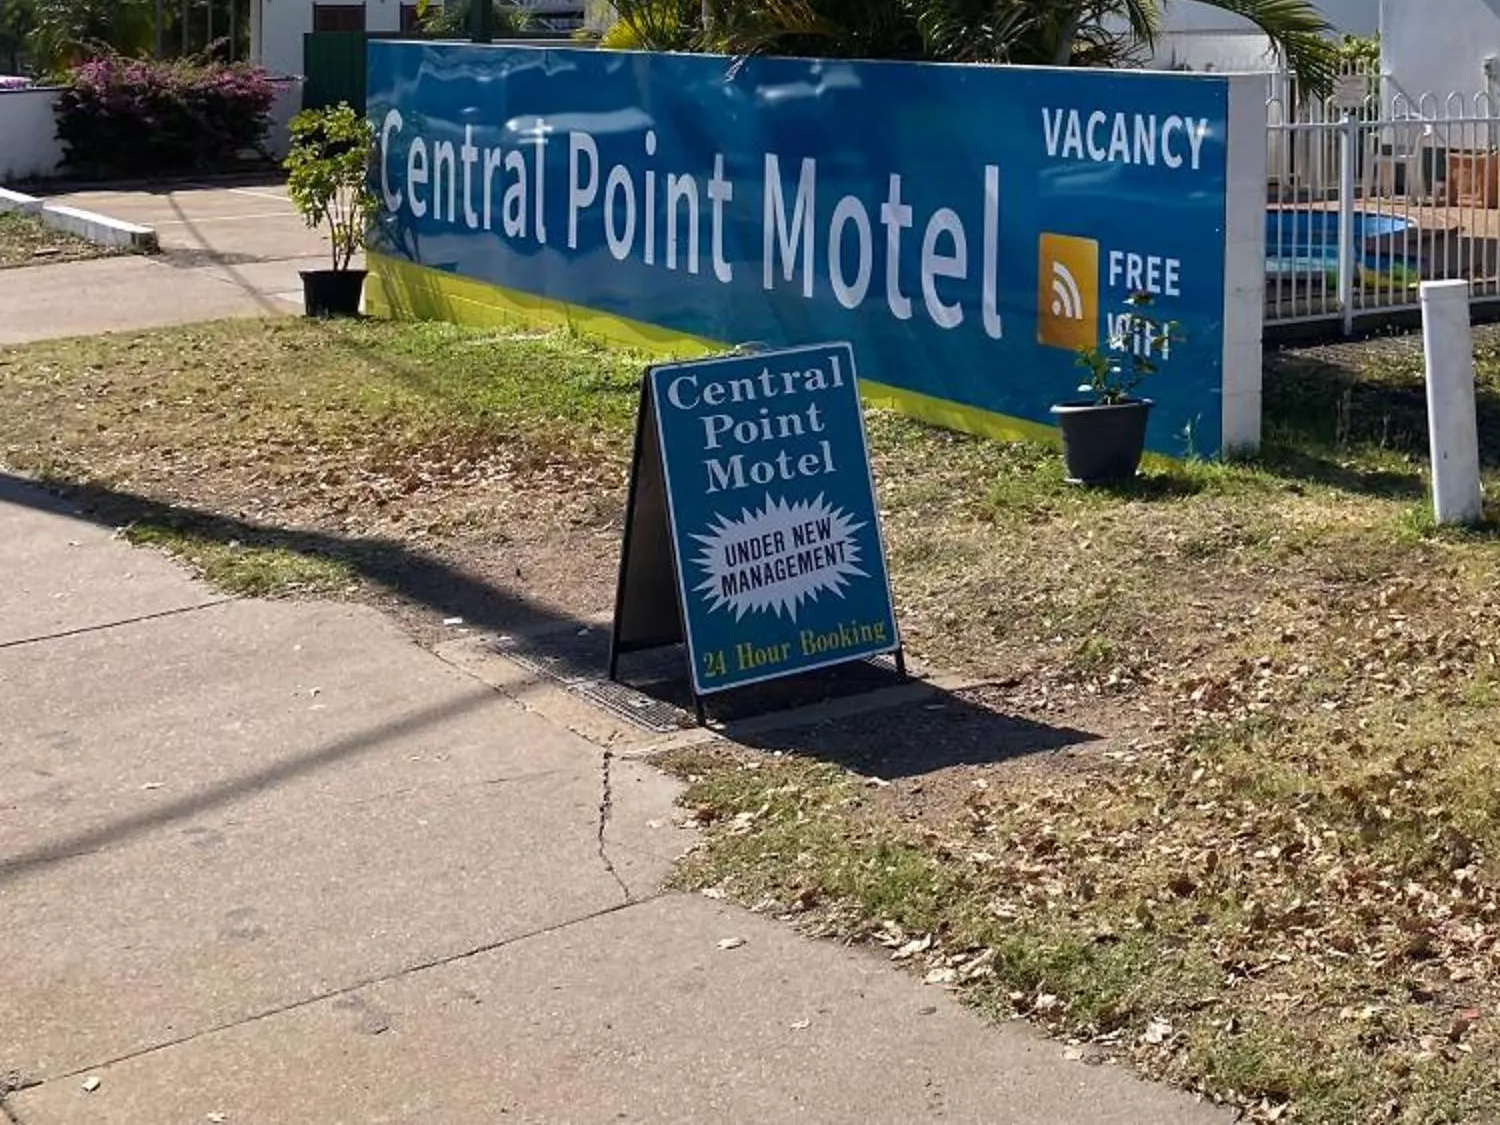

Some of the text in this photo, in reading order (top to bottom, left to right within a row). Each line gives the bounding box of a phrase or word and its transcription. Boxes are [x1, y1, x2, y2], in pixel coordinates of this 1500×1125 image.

[1041, 107, 1208, 170] VACANCY
[380, 108, 1002, 340] Central Point Motel
[1109, 250, 1181, 296] FREE
[667, 356, 844, 411] Central
[700, 402, 825, 450] Point
[704, 441, 837, 494] Motel
[721, 539, 846, 598] MANAGEMENT
[724, 516, 832, 568] UNDER NEW
[703, 618, 886, 677] 24 Hour Booking
